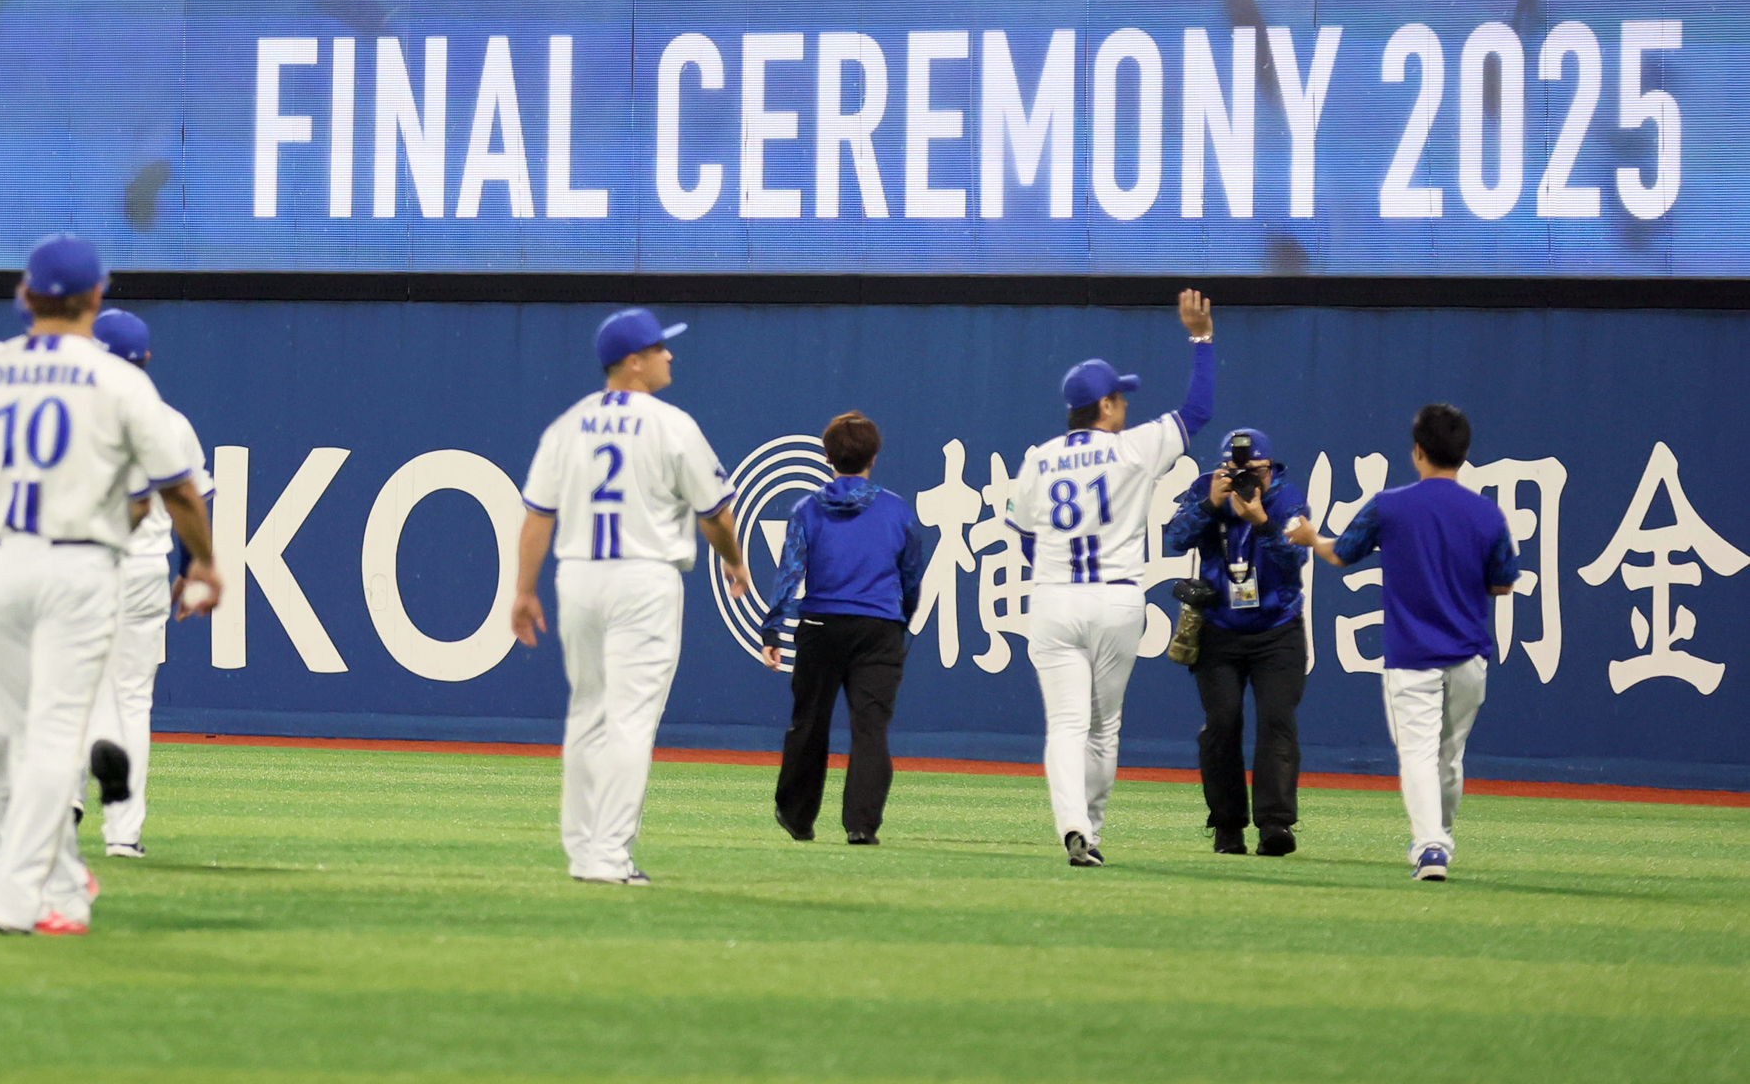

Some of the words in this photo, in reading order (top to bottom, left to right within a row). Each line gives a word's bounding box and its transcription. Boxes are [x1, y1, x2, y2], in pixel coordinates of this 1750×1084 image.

[252, 32, 608, 221] FINAL
[655, 25, 1343, 221] CEREMONY
[1379, 20, 1683, 223] 2025
[581, 416, 643, 437] MAKI
[590, 442, 626, 503] 2
[1038, 447, 1118, 474] D.MIURA
[1048, 472, 1112, 532] 81
